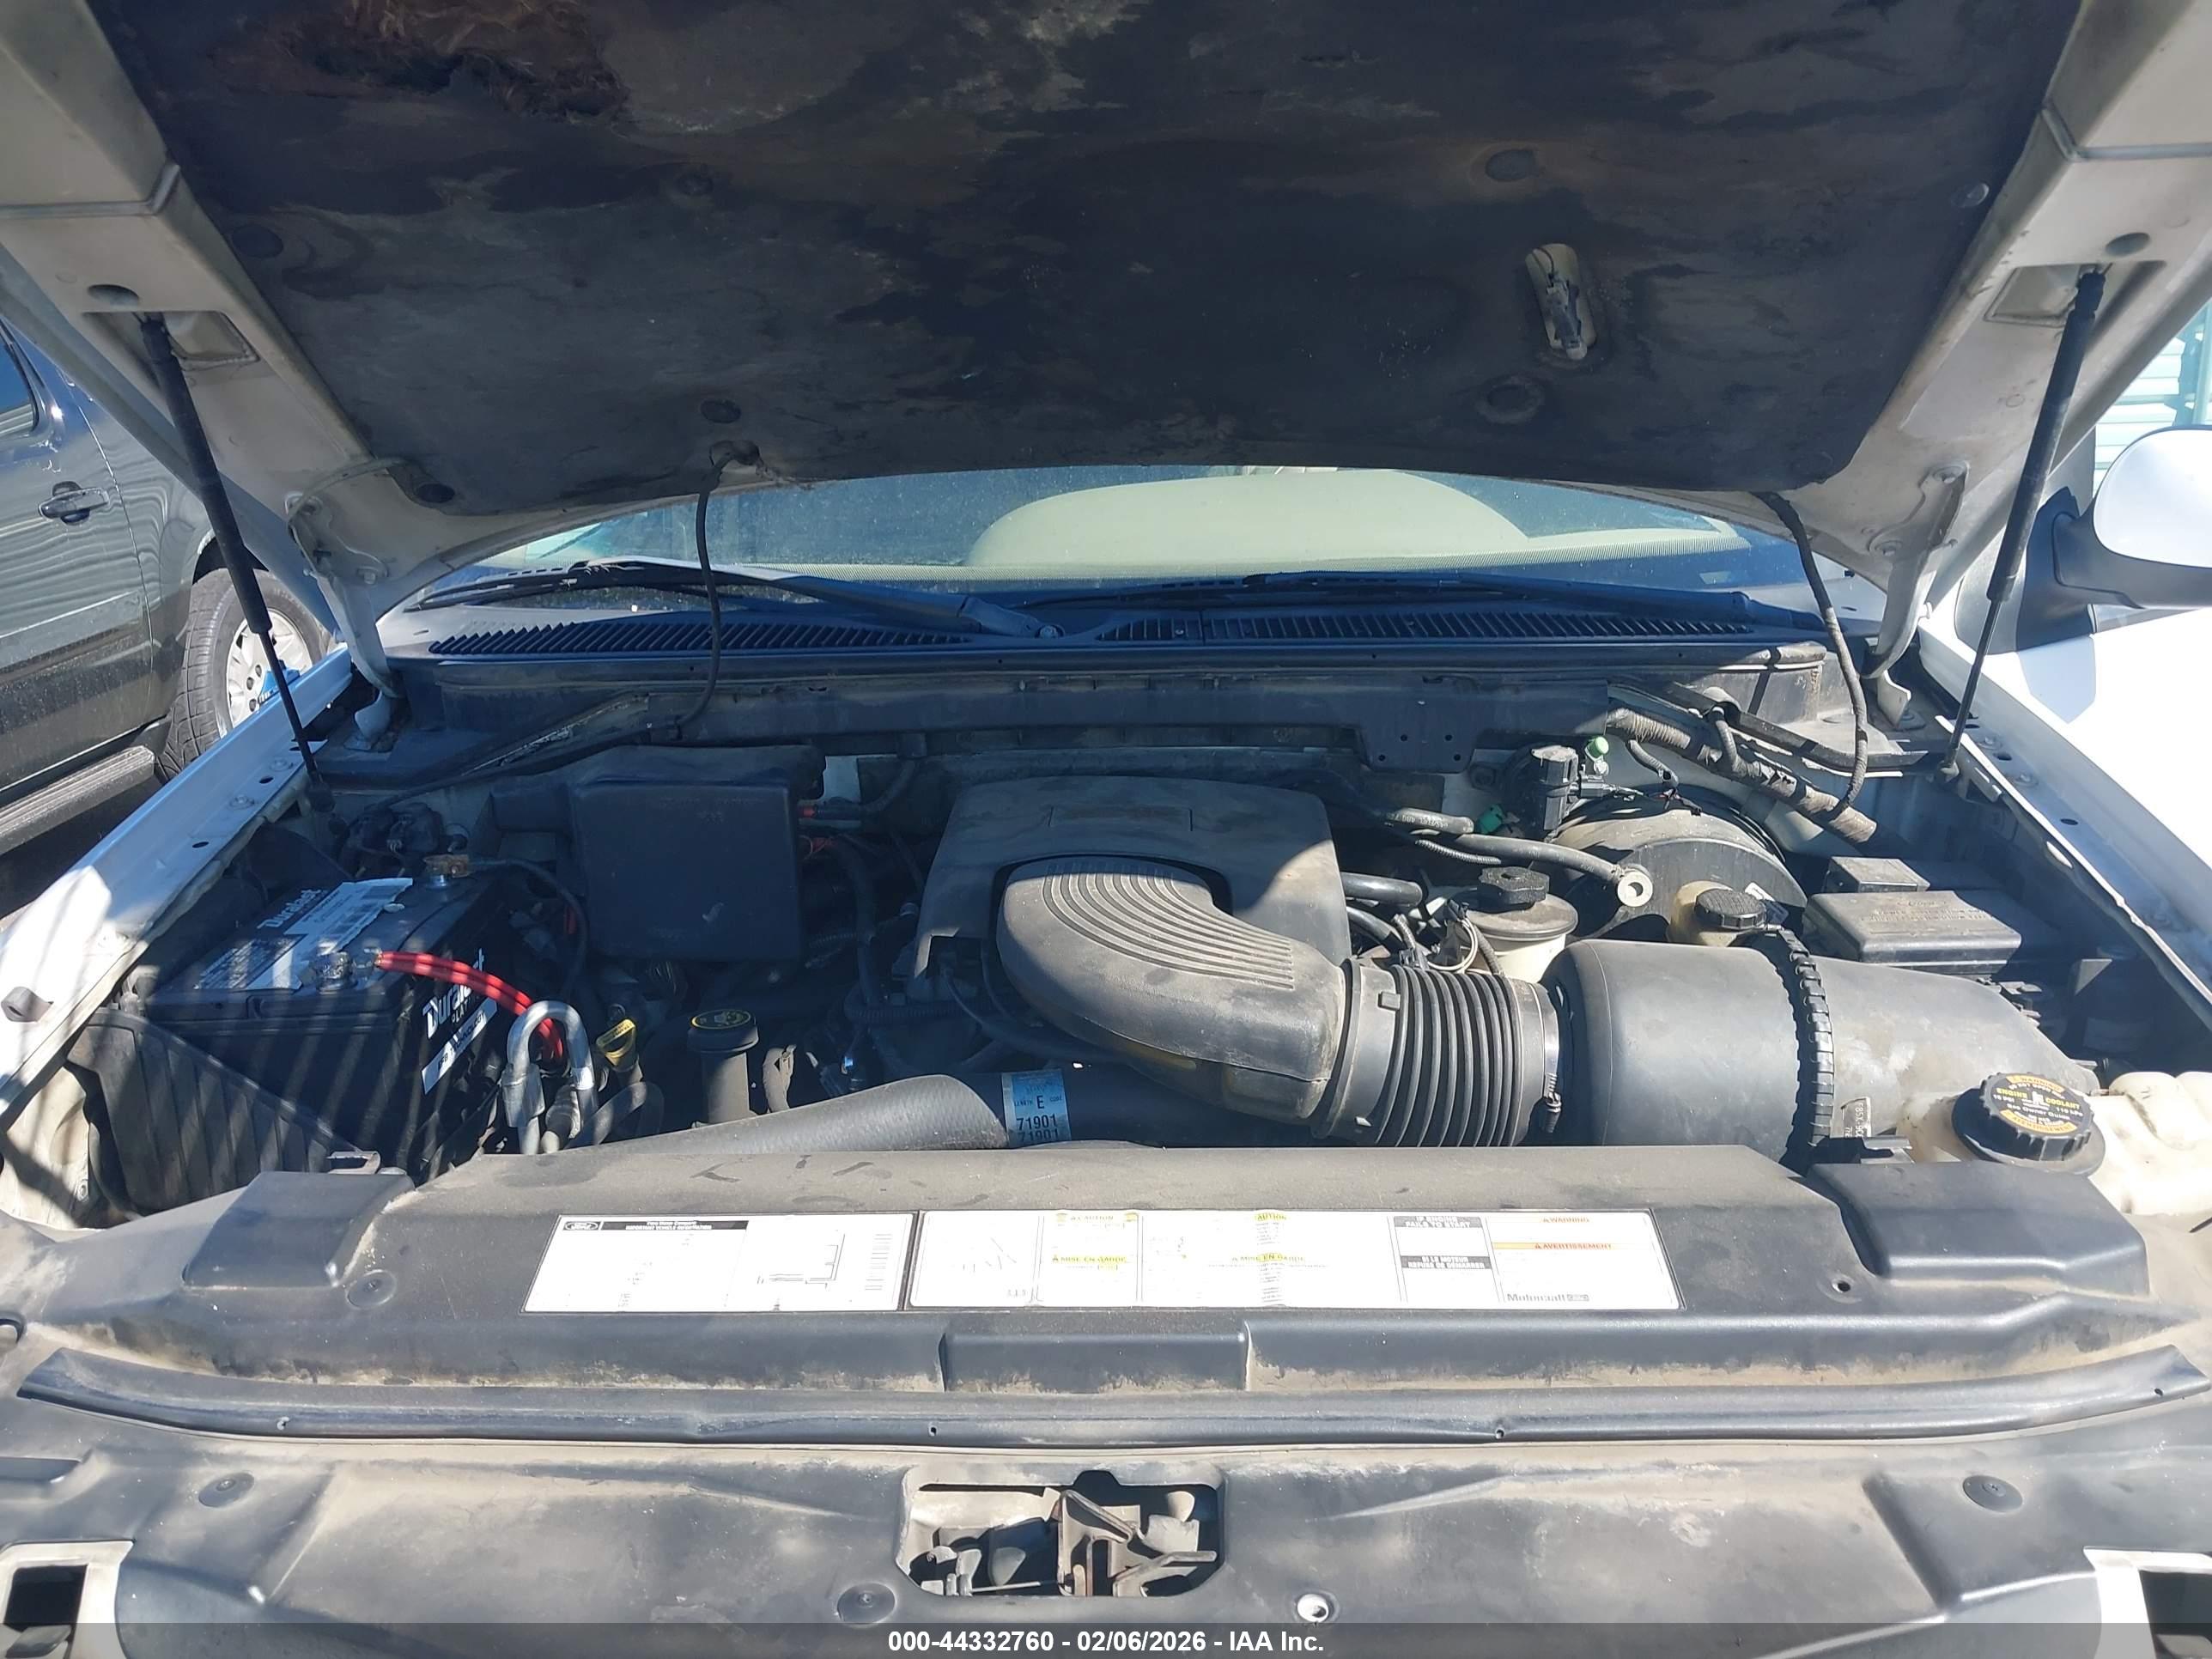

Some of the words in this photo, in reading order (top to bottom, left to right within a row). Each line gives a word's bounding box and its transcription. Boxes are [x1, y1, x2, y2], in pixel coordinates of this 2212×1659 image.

[257, 888, 322, 929] Duralast
[422, 947, 485, 1039] Duralt
[1036, 1095, 1045, 1109] E
[1996, 1087, 2027, 1099] ENGINE
[2045, 1097, 2081, 1109] COOLANT
[2022, 1106, 2046, 1115] Owner
[1016, 1113, 1058, 1131] 71901
